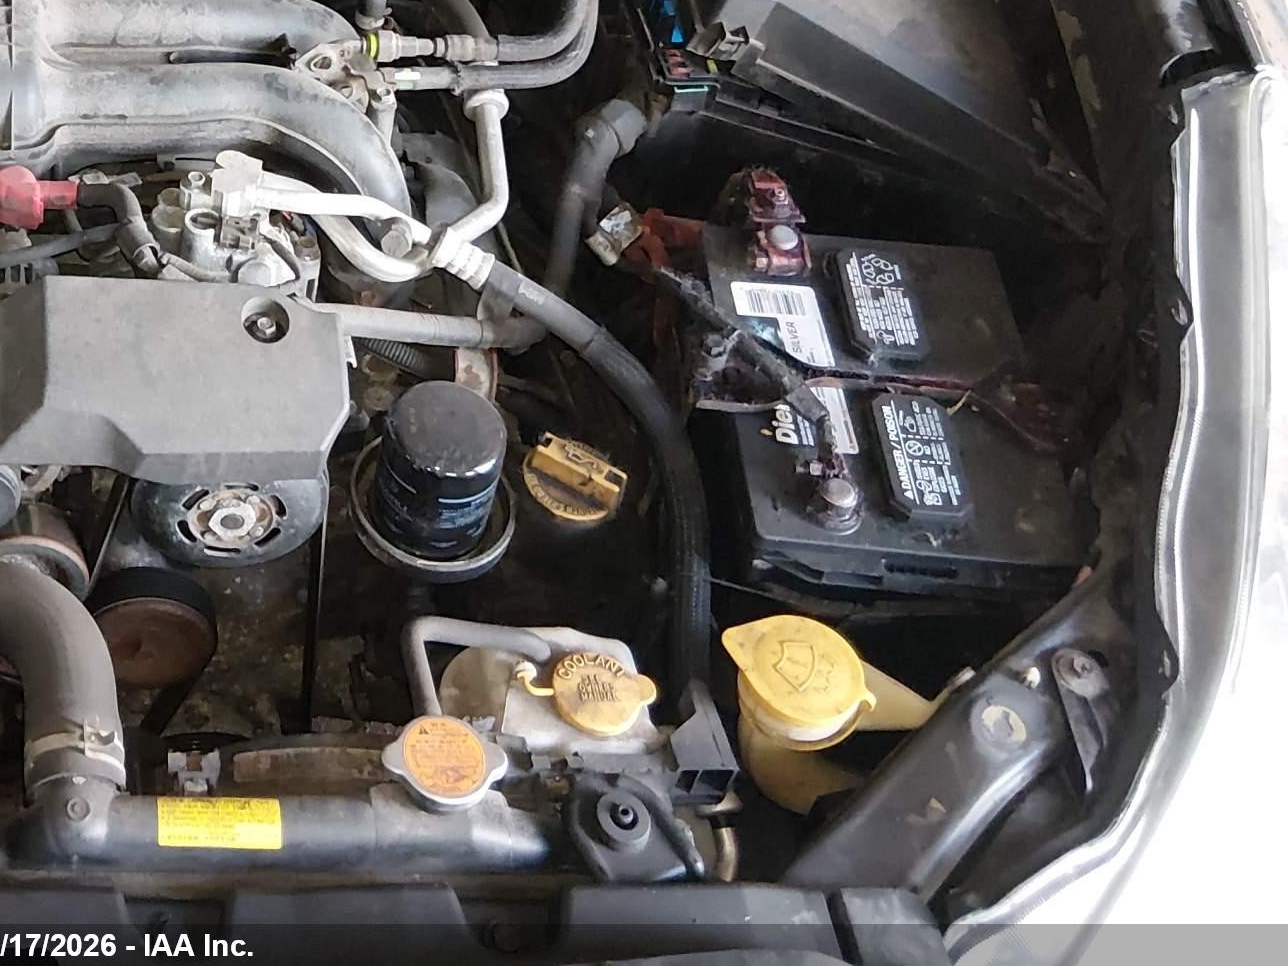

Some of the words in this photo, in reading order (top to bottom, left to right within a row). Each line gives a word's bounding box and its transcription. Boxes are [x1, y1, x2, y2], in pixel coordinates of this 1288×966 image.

[785, 321, 802, 354] SILVER
[881, 405, 899, 441] POISON
[892, 449, 912, 490] DANGER
[558, 653, 625, 680] COOLANT
